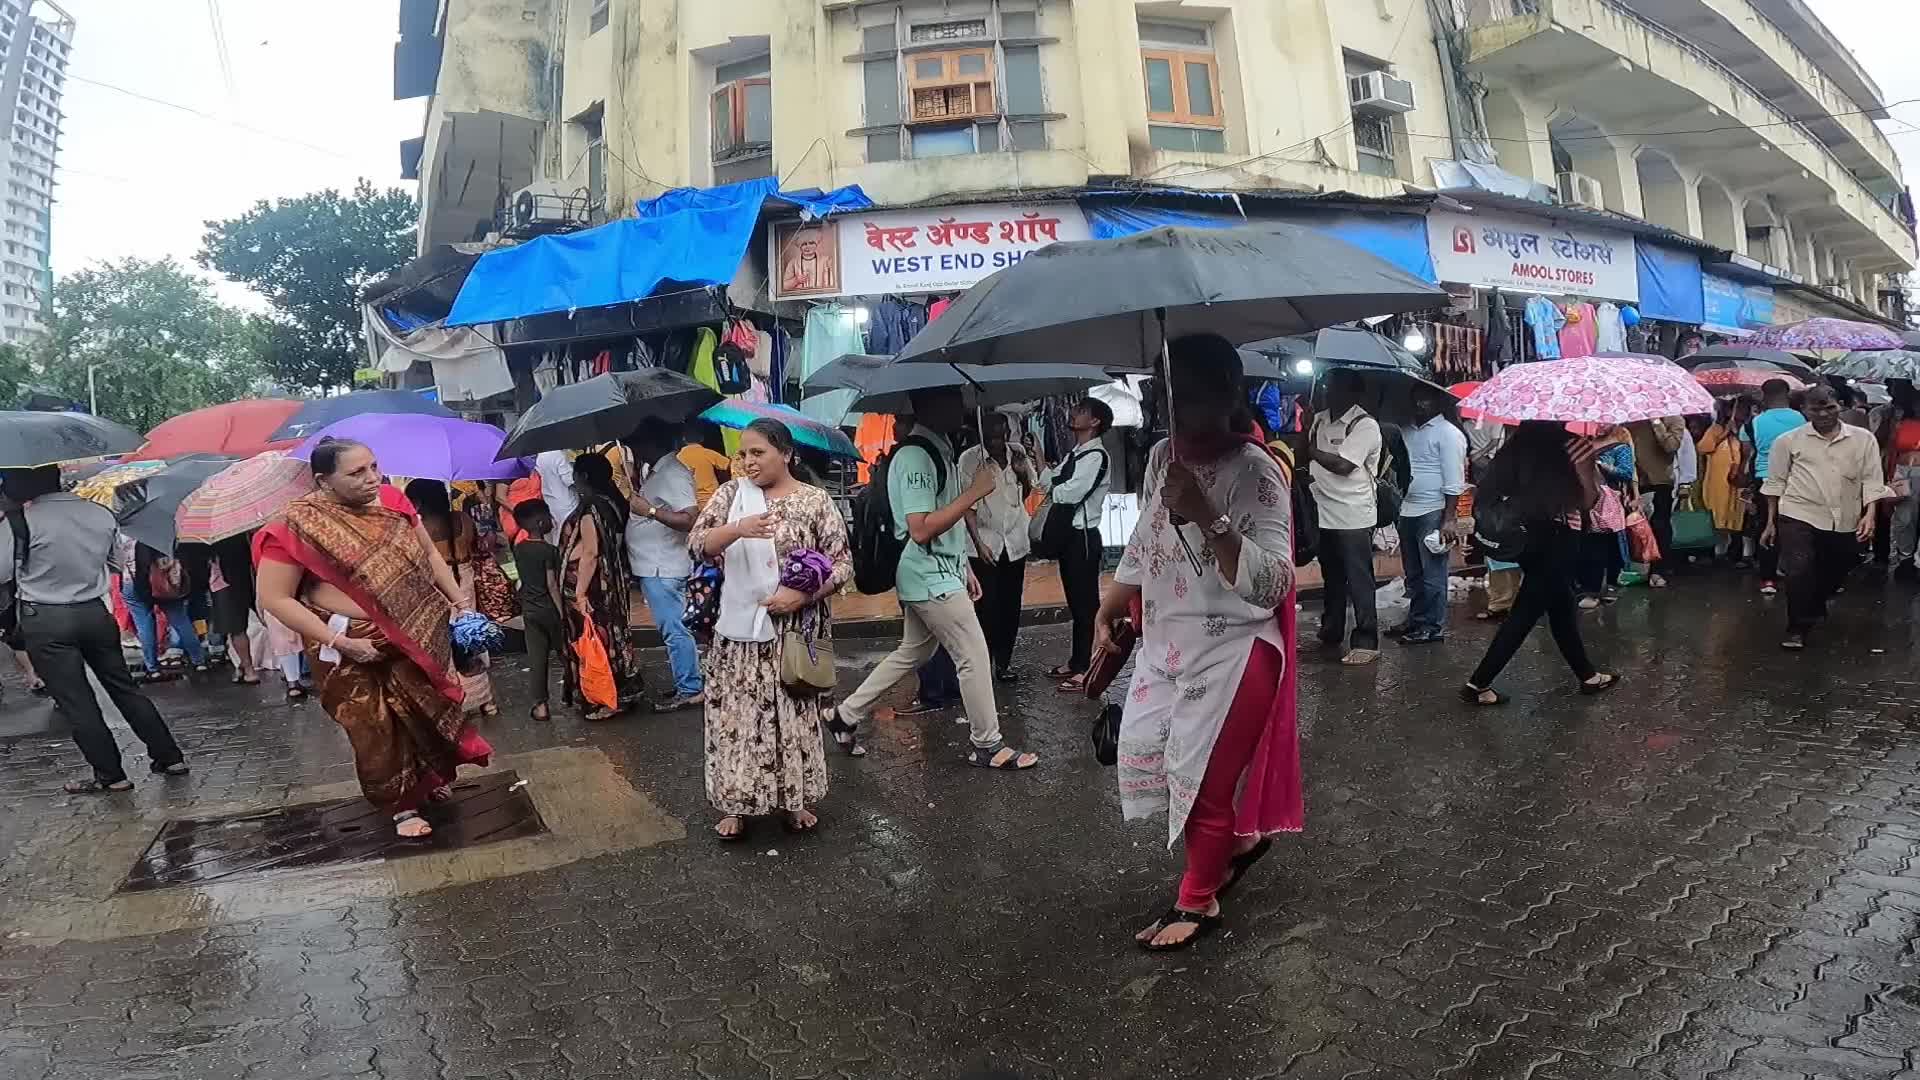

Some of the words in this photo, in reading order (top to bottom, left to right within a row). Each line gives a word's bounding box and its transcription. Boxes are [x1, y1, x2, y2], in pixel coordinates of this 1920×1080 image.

[864, 222, 919, 252] वेस्ट
[1000, 212, 1061, 243] शॉप
[872, 255, 933, 274] WEST
[941, 252, 985, 270] END
[1511, 262, 1553, 281] AMOOL
[1555, 267, 1594, 285] STORES
